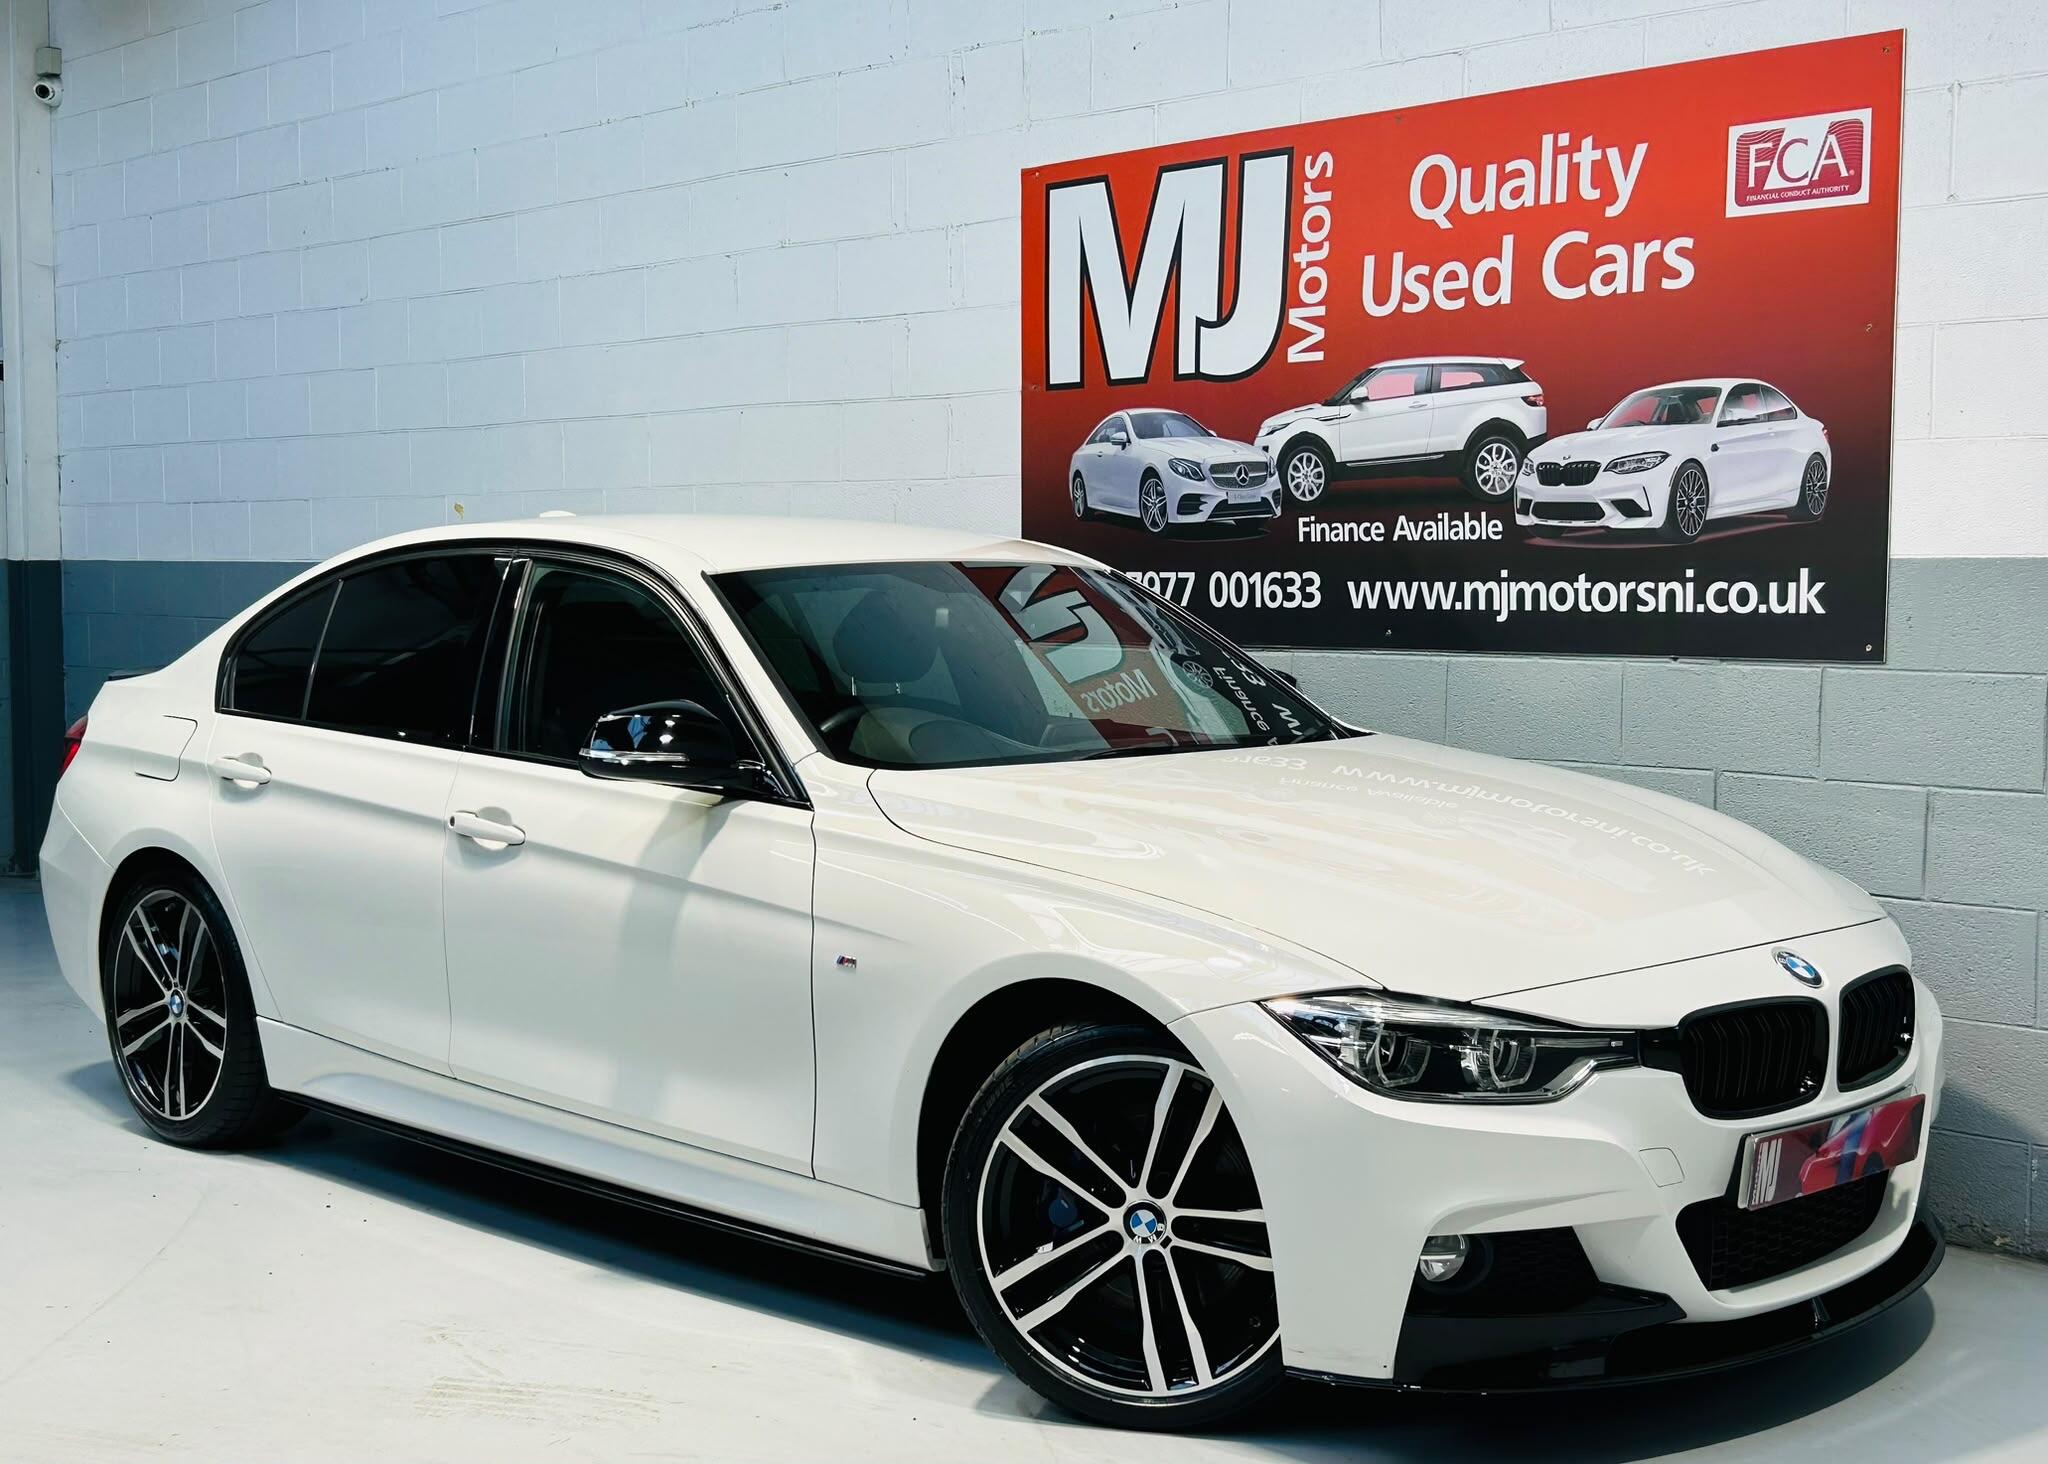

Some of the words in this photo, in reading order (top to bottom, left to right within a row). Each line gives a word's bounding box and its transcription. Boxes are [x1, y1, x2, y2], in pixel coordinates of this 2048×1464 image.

[1409, 132, 1649, 230] Quality
[1746, 192, 1780, 202] FINANCIAL
[1780, 188, 1811, 199] CONDUCT
[1811, 184, 1850, 196] AUTHORITY
[1047, 148, 1293, 390] MJ
[1287, 151, 1334, 363] Motors
[1362, 234, 1514, 317] Used
[1542, 230, 1695, 300] Cars
[1298, 515, 1385, 543] Finance
[1392, 511, 1504, 542] Available
[1208, 570, 1322, 609] 001633
[1346, 567, 1826, 623] www.mjmotorsni.co.uk
